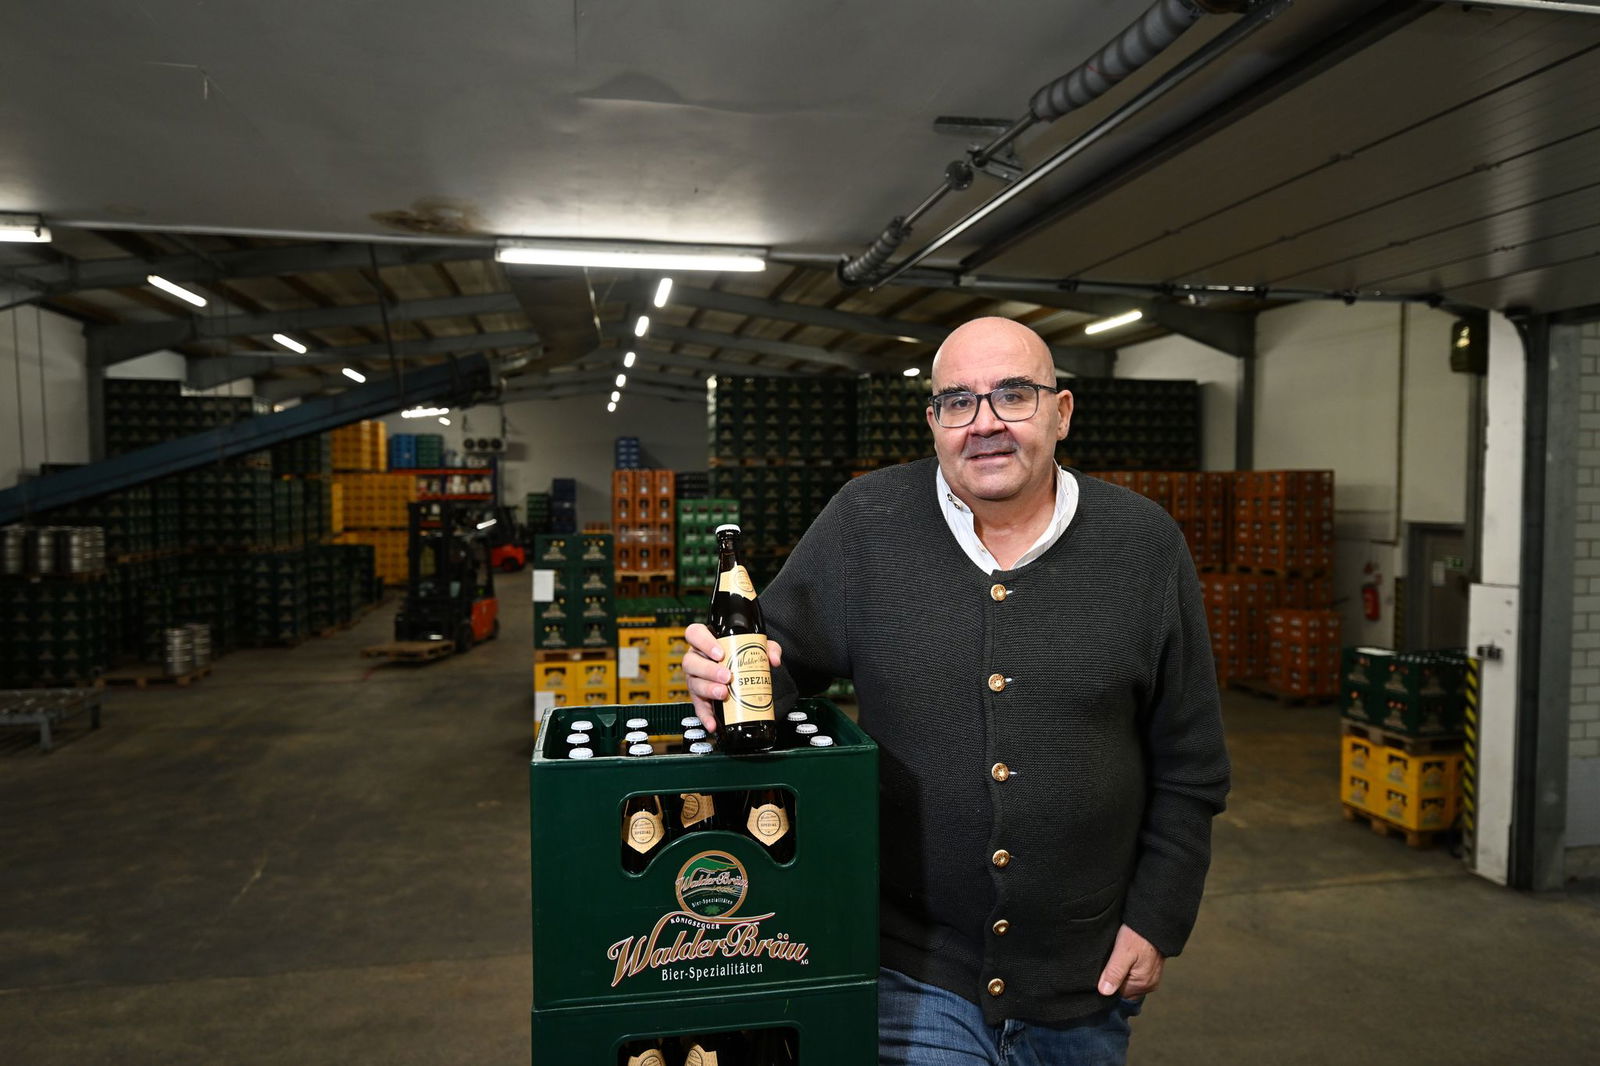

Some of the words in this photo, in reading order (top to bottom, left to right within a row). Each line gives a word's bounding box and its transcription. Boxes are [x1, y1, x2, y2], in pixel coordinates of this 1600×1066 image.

[738, 676, 771, 686] SPEZIAL
[670, 916, 720, 930] KÖNIGSEGGER
[661, 962, 763, 982] Bier-Spezialitäten
